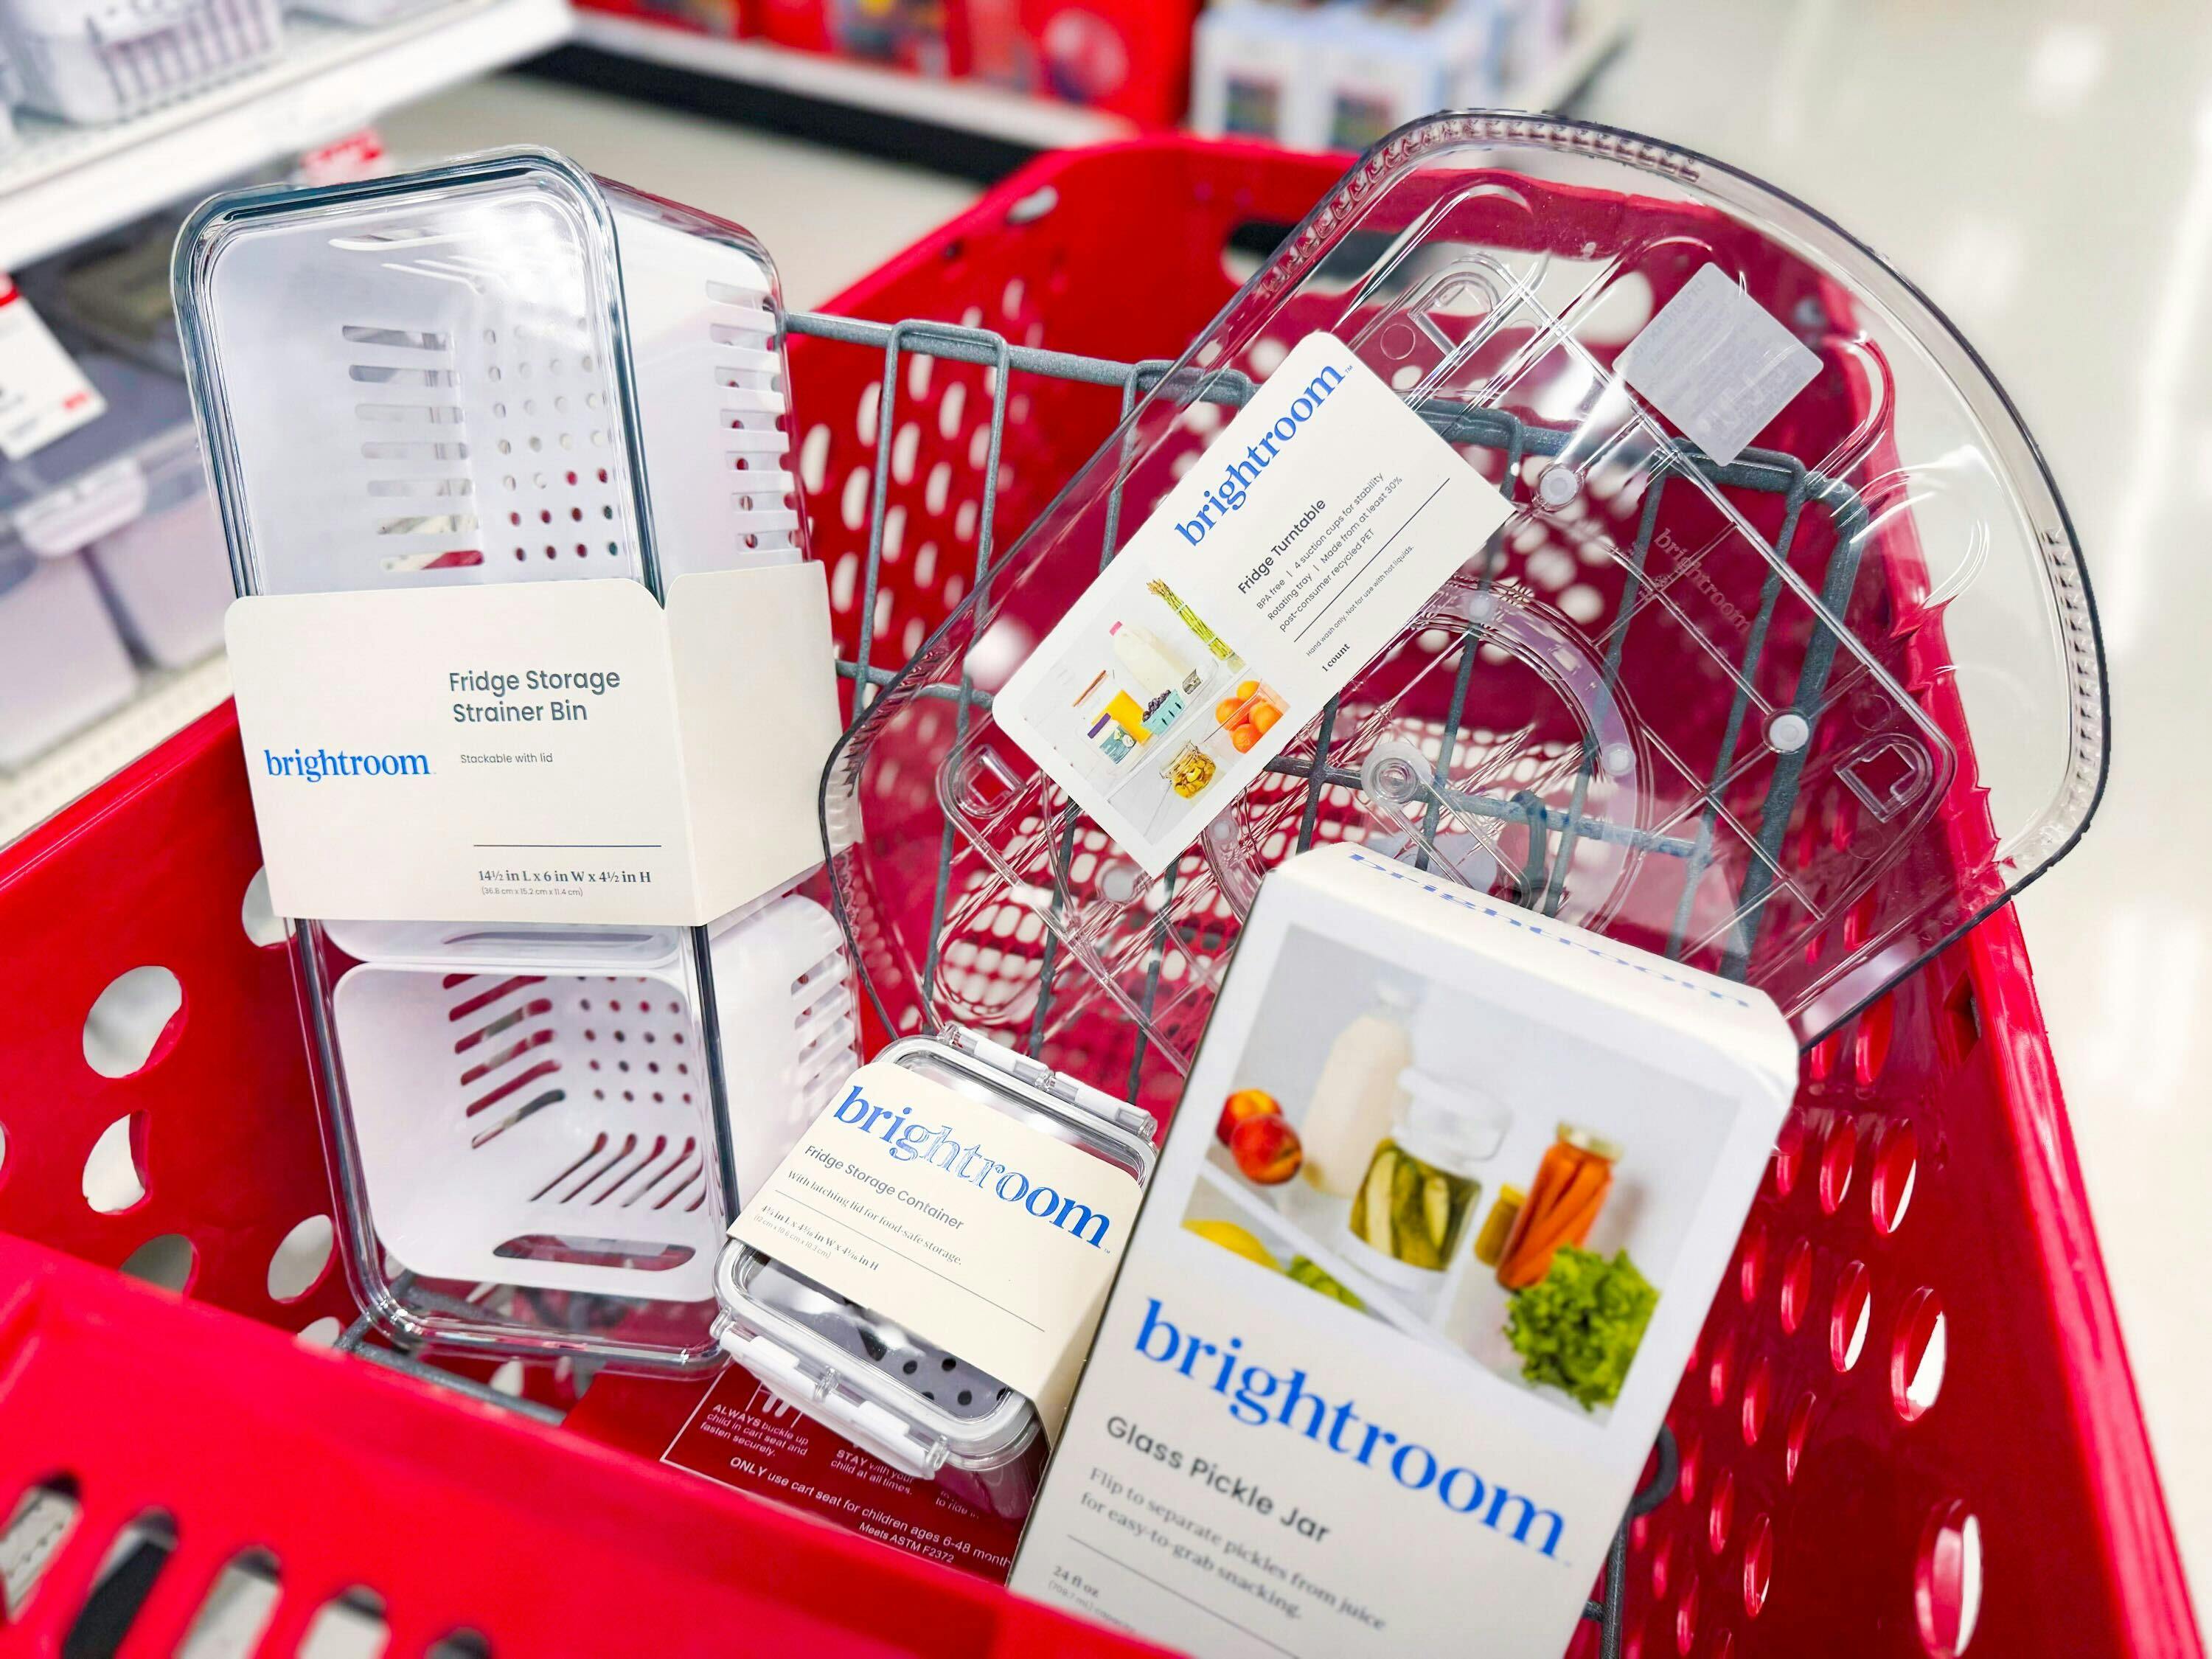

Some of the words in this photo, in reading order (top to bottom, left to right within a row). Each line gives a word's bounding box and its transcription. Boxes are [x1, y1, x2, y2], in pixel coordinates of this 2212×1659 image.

[1237, 557, 1274, 594] Fridge
[1270, 500, 1326, 556] Turntable
[1256, 594, 1272, 610] BPA
[1269, 580, 1285, 595] free
[1295, 561, 1301, 569] 4
[1300, 535, 1327, 563] suction
[1326, 515, 1344, 535] cups
[1342, 504, 1354, 517] for
[1353, 473, 1384, 505] stability
[1267, 588, 1299, 620] Rotating
[1295, 573, 1312, 590] tray
[1320, 540, 1343, 563] Made
[1340, 522, 1360, 542] from
[1359, 512, 1369, 523] at
[1366, 493, 1387, 514] least
[1385, 476, 1403, 494] 30%
[1279, 574, 1332, 633] post-consumer
[1331, 542, 1363, 577] recycled
[1360, 528, 1374, 544] PET
[1306, 640, 1322, 657] Hand
[1320, 627, 1335, 642] wash
[1345, 604, 1357, 616] Not
[1354, 596, 1364, 606] for
[1363, 586, 1374, 598] use
[1372, 574, 1385, 588] with
[1383, 564, 1395, 576] hot
[1392, 546, 1413, 566] liquids.
[1327, 644, 1350, 667] count
[450, 670, 519, 697] Fridge
[526, 670, 619, 695] Storage
[453, 701, 543, 722] Strainer
[551, 700, 587, 720] Bin
[265, 749, 429, 782] brightroom
[461, 754, 512, 763] Stackable
[515, 754, 537, 762] with
[540, 753, 552, 762] lid
[481, 886, 501, 896] (36.8
[567, 887, 583, 897] cm)
[505, 869, 520, 881] in
[522, 870, 532, 881] L
[533, 873, 541, 882] x
[543, 871, 552, 882] 6
[554, 870, 568, 882] in
[570, 871, 585, 882] W
[588, 873, 596, 883] x
[622, 870, 637, 883] in
[639, 872, 651, 883] H
[804, 1145, 844, 1169] Fridge
[844, 1164, 896, 1195] Storage
[897, 1190, 964, 1230] Container
[788, 1170, 810, 1186] With
[810, 1181, 849, 1207] latching
[849, 1201, 865, 1214] lid
[863, 1208, 879, 1220] for
[878, 1216, 923, 1244] food-safe
[925, 1241, 961, 1265] storage.
[813, 1231, 824, 1242] in
[826, 1237, 836, 1247] W
[858, 1255, 869, 1266] in
[869, 1262, 879, 1270] H
[700, 1421, 731, 1439] fasten
[732, 1435, 775, 1456] securely.
[706, 1413, 732, 1427] child
[731, 1422, 742, 1431] in
[742, 1427, 763, 1440] cart
[764, 1435, 787, 1448] seat
[787, 1444, 808, 1456] and
[712, 1404, 762, 1427] ALWAYS
[761, 1422, 794, 1440] buckle
[795, 1436, 809, 1446] up
[1135, 1298, 1568, 1559] brightroom
[830, 1460, 856, 1474] child
[856, 1470, 868, 1478] at
[869, 1475, 883, 1484] all
[882, 1478, 912, 1495] times.
[836, 1450, 868, 1467] STAY
[869, 1462, 890, 1475] with
[1107, 1416, 1183, 1470] Glass
[1189, 1458, 1273, 1514] Pickle
[1280, 1509, 1329, 1542] Jar
[730, 1457, 768, 1477] ONLY
[767, 1472, 790, 1486] use
[790, 1481, 815, 1496] cart
[815, 1491, 842, 1507] seat
[843, 1499, 860, 1513] for
[861, 1509, 908, 1531] children
[910, 1526, 940, 1543] ages
[942, 1536, 971, 1554] 6-48
[935, 1498, 946, 1507] to
[859, 1522, 889, 1540] Meets
[889, 1534, 922, 1551] ASTM
[922, 1545, 955, 1563] F2372
[1080, 1492, 1106, 1513] for
[1107, 1509, 1215, 1571] easy-to-grab
[1217, 1567, 1301, 1619] snacking.
[1090, 1467, 1124, 1495] Flip
[1126, 1487, 1145, 1506] to
[1148, 1500, 1222, 1545] separate
[1223, 1540, 1287, 1580] pickles
[1290, 1573, 1337, 1607] from
[1338, 1599, 1385, 1630] juice
[1054, 1566, 1069, 1581] 24
[1071, 1576, 1082, 1587] fl
[1083, 1585, 1099, 1598] oz
